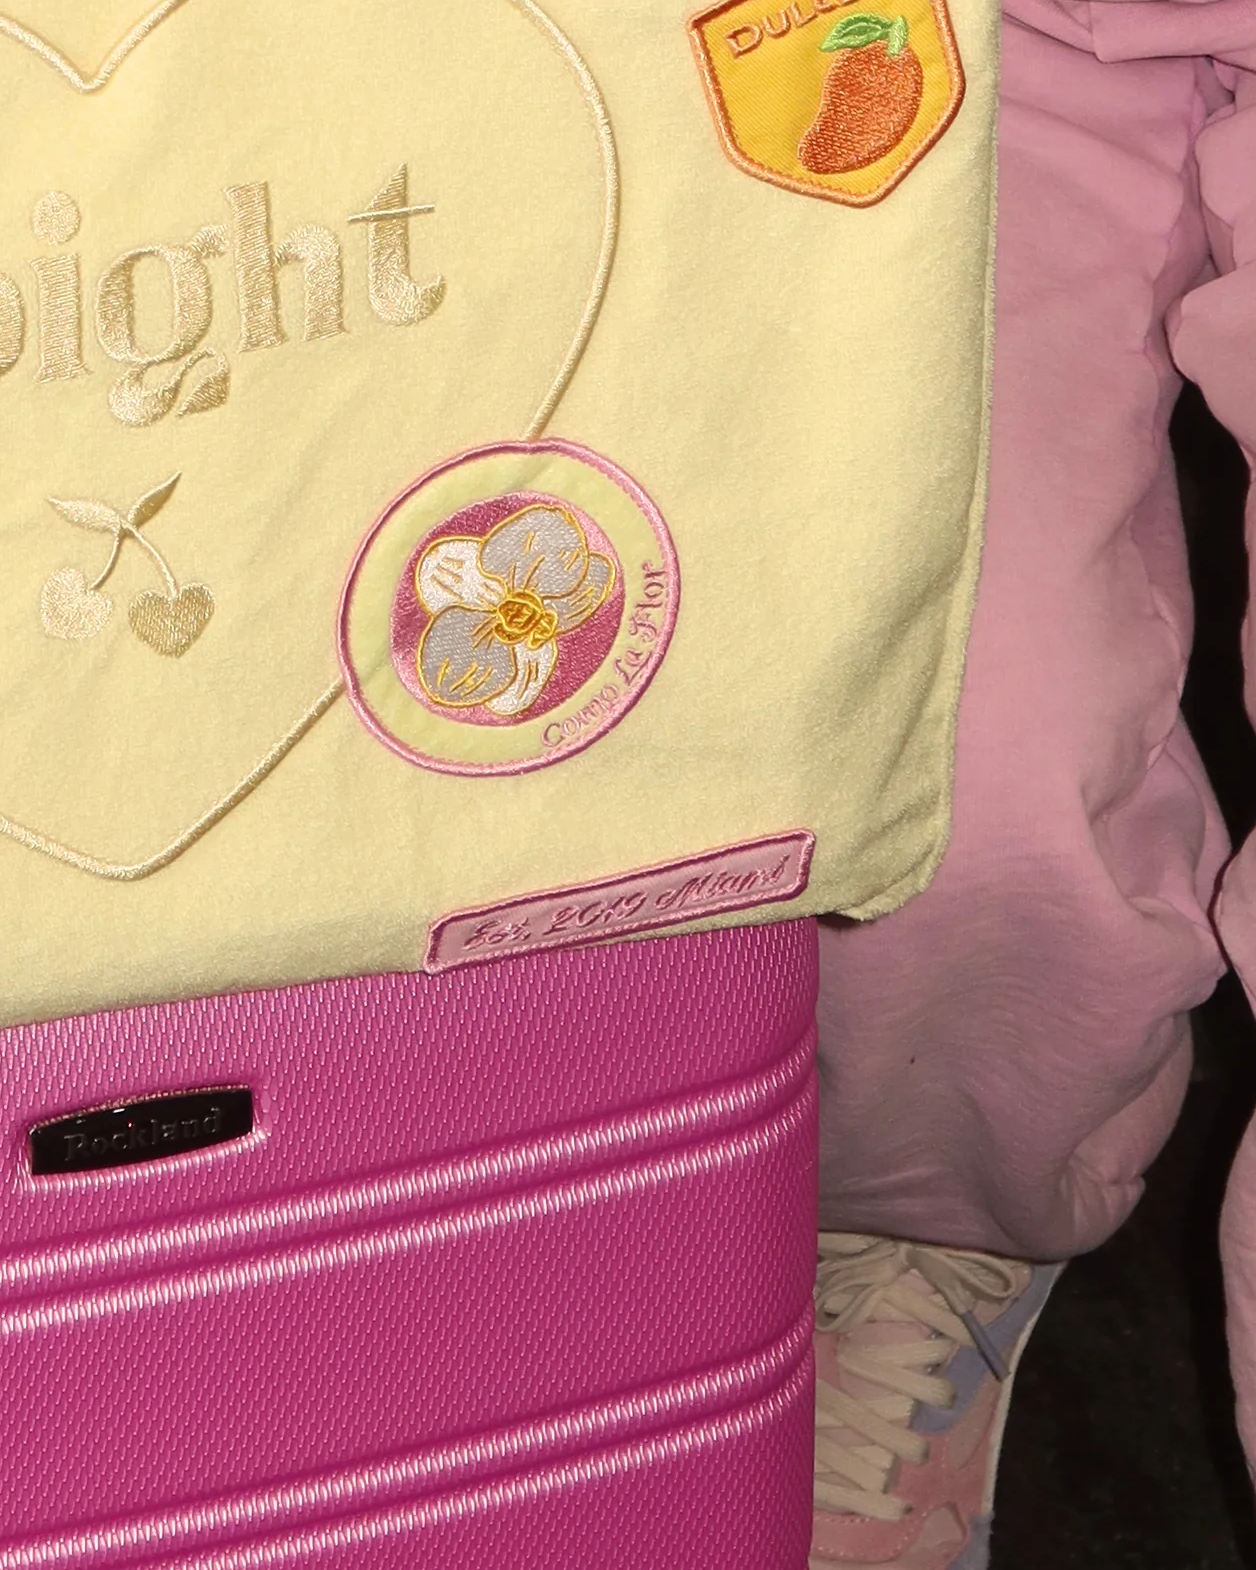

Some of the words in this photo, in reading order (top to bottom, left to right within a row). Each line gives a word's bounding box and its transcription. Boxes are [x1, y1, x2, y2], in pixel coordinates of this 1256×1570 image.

[628, 560, 668, 644] Flor
[613, 642, 653, 688] La
[542, 683, 621, 749] Como
[544, 892, 648, 935] 2019
[655, 854, 790, 910] Miami
[63, 1106, 222, 1162] Rockland
